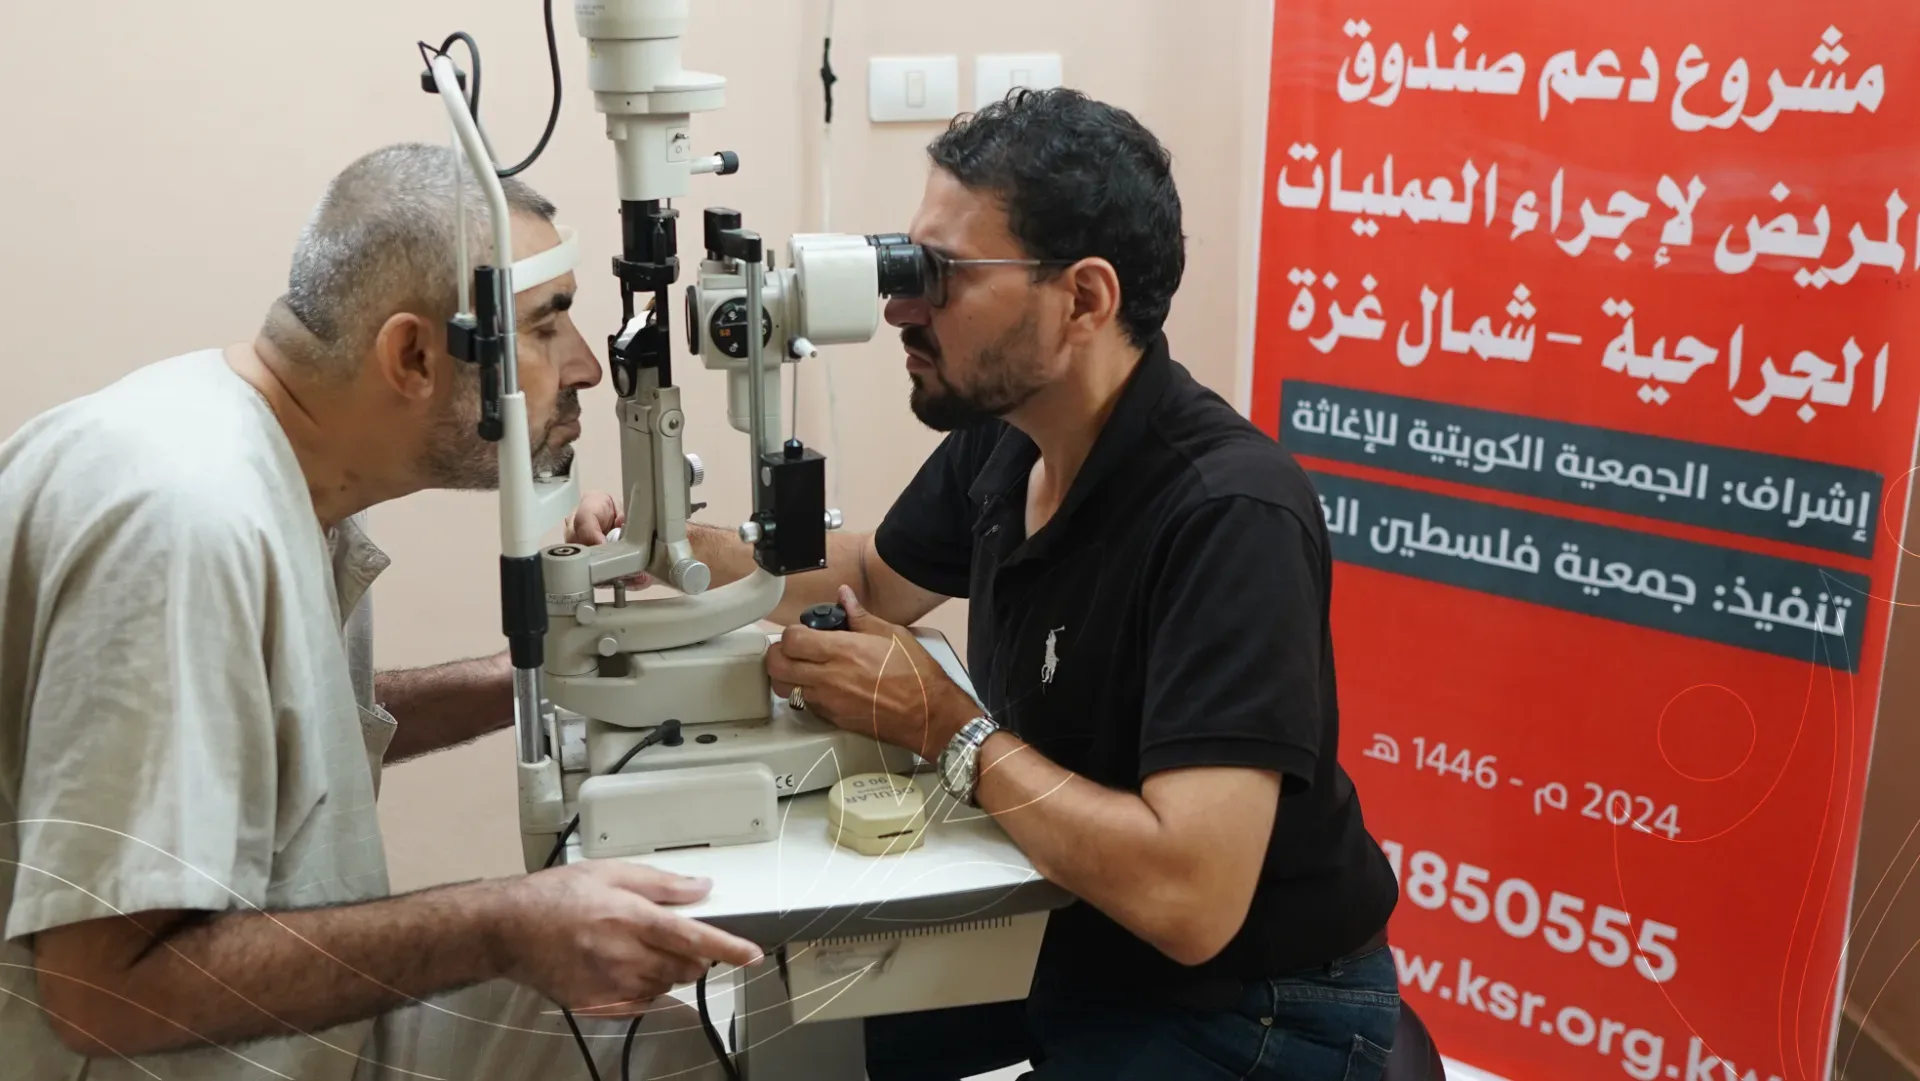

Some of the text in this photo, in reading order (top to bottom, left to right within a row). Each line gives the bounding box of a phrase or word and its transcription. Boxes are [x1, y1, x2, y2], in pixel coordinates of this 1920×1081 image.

[1337, 18, 1885, 132] مشروع دعم صندوق
[1277, 142, 1498, 238] العمليات
[1510, 168, 1707, 268] لإجراء
[1287, 268, 1386, 353] غزة
[1397, 284, 1536, 367] شمال
[1601, 298, 1889, 424] الجراحية
[1291, 396, 1871, 542] إشراف: الجمعية الكويتية للإغاثة
[1369, 512, 1540, 574] فلسطين
[1554, 541, 1697, 614] جمعية
[1713, 576, 1852, 637] تنفيذ:
[844, 786, 916, 804] OCULAR
[1413, 737, 1498, 789] 1446
[1533, 782, 1568, 815] م
[1581, 782, 1681, 839] 2024
